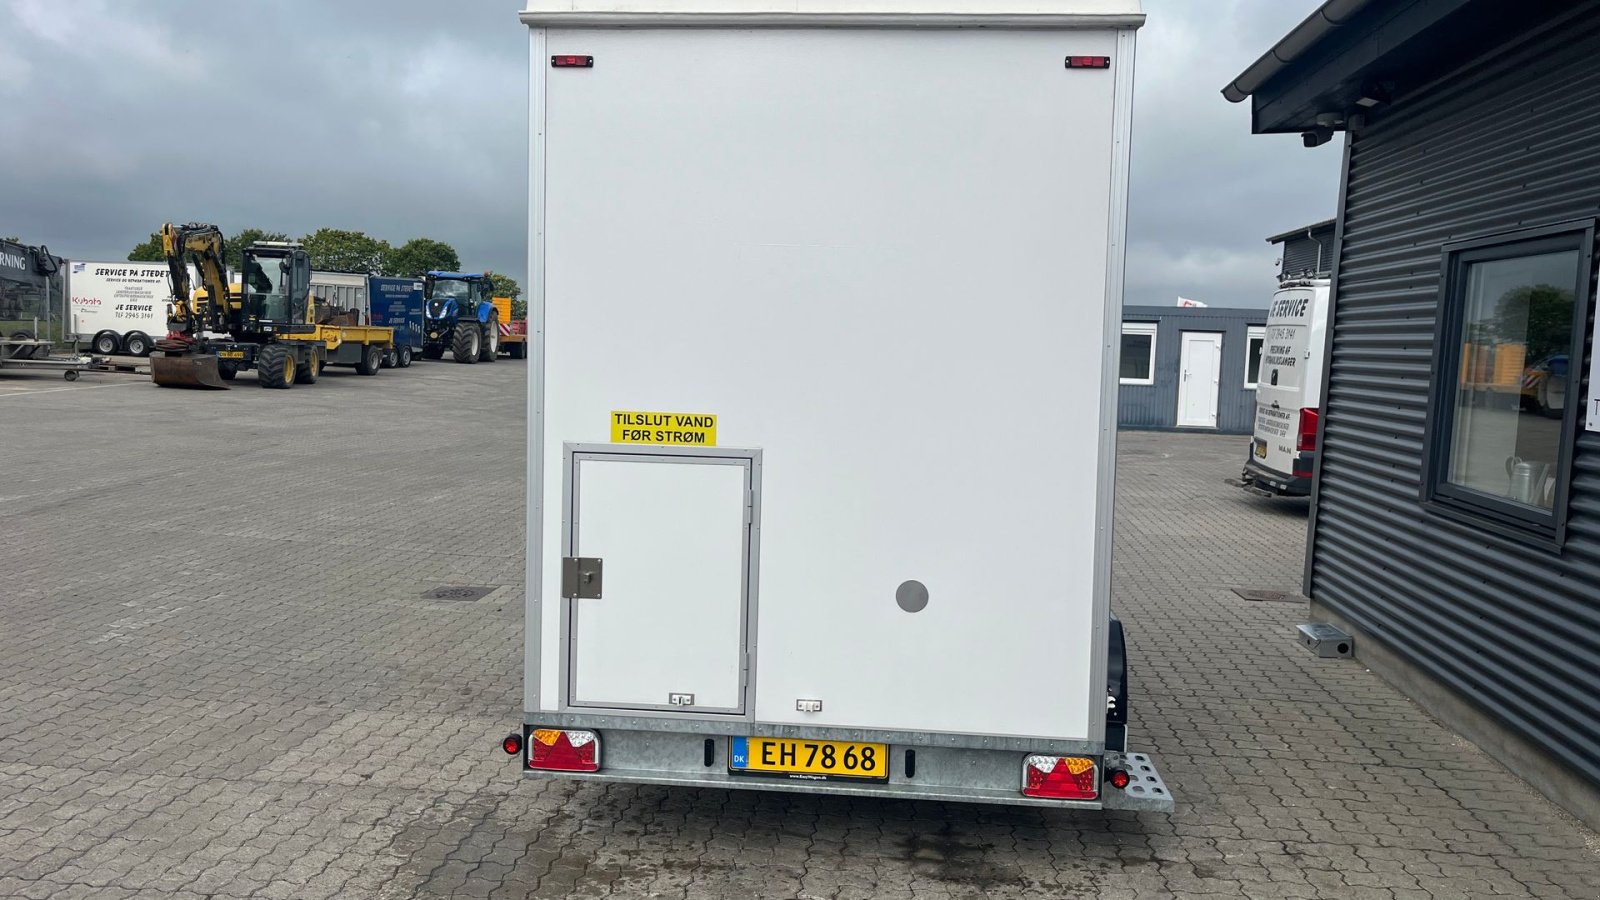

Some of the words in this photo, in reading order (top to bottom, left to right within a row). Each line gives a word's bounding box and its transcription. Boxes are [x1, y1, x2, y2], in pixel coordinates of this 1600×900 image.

[95, 268, 128, 277] SERVICE
[142, 270, 171, 278] STEDET
[72, 296, 102, 306] Kubota
[115, 304, 123, 312] JE
[126, 304, 153, 312] SERVICE
[1276, 298, 1309, 318] SERVICE
[614, 413, 671, 427] TILSLUT
[675, 415, 714, 428] VAND
[622, 429, 652, 442] FØR
[655, 430, 705, 443] STRØM
[734, 755, 745, 763] DK
[761, 741, 796, 767] EH
[804, 743, 836, 769] 78
[843, 745, 876, 771] 68
